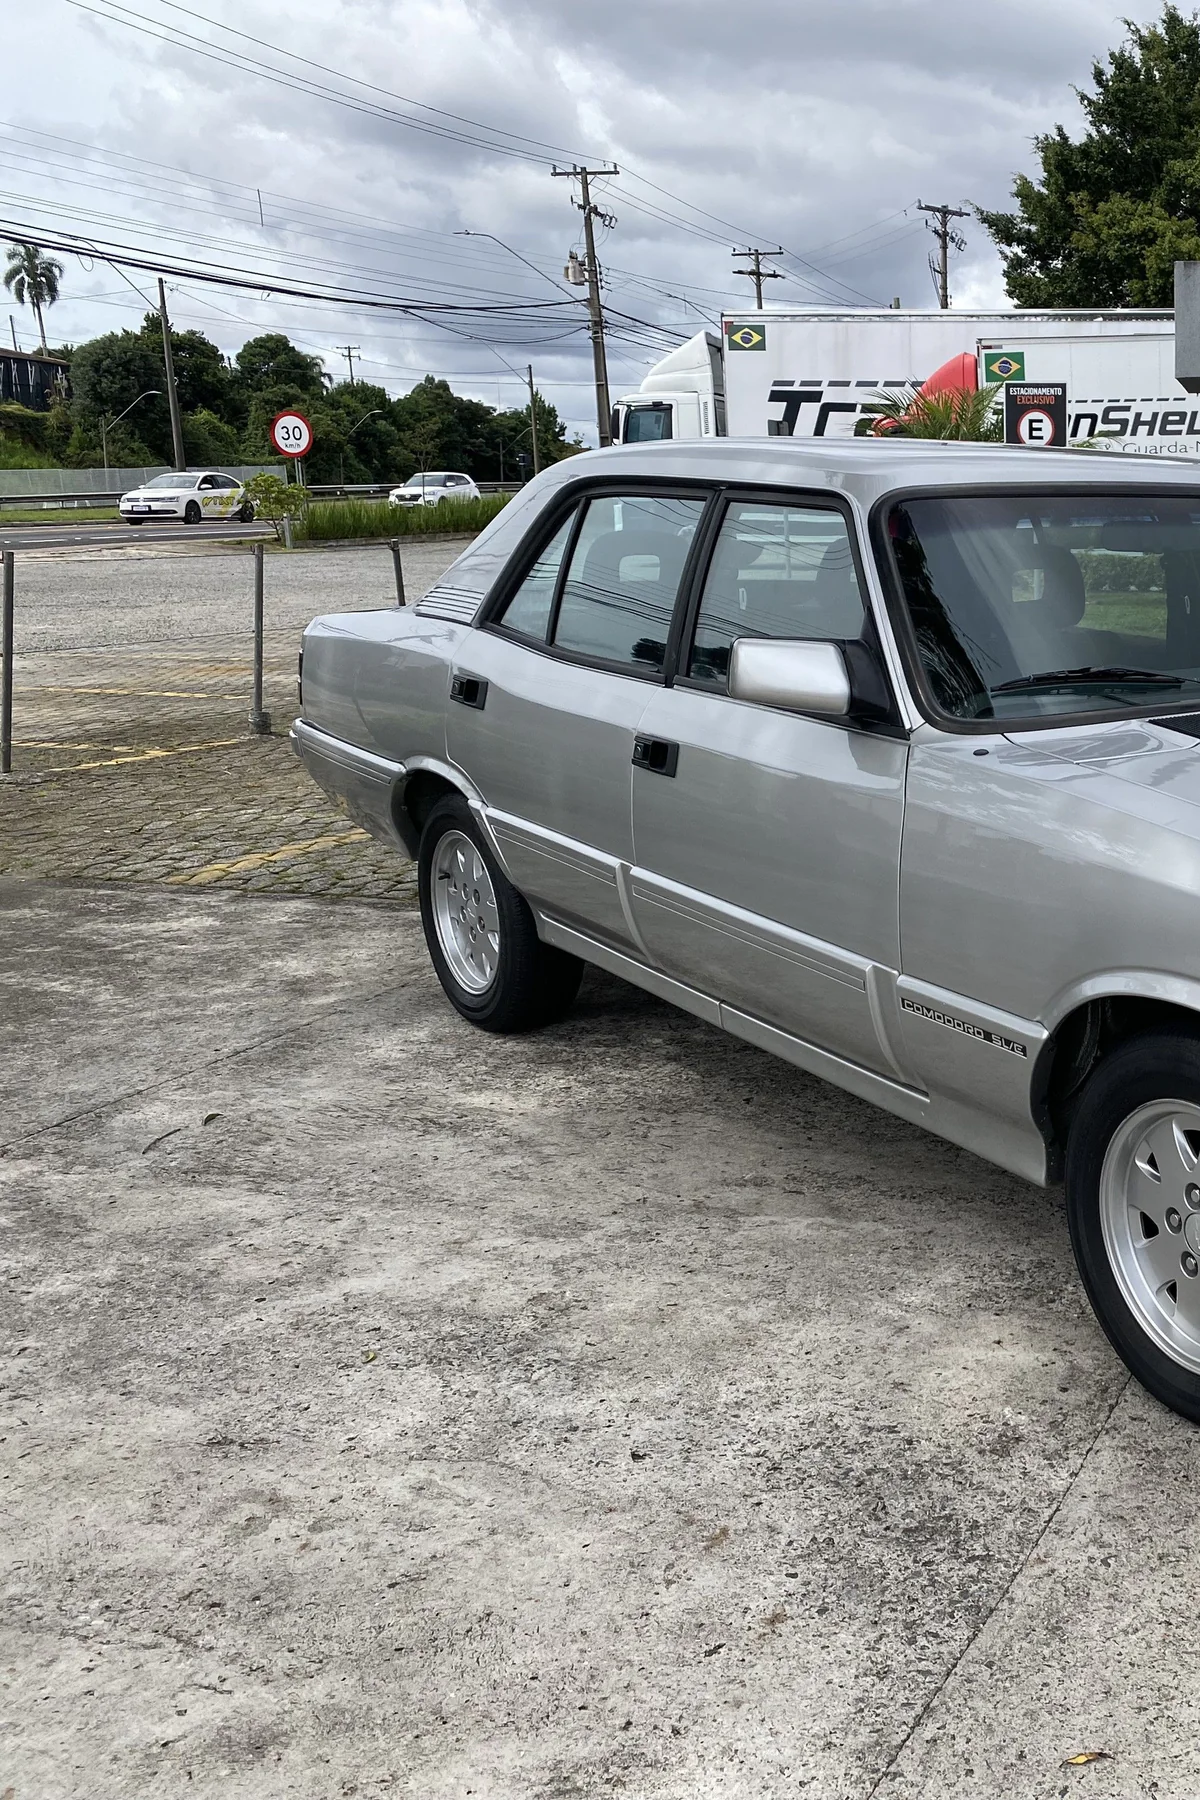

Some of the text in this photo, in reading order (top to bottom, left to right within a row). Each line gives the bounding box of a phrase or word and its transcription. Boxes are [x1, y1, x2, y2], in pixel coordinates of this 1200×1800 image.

[1009, 387, 1063, 396] ESTACIONAMENTO
[1016, 395, 1056, 405] EXCLUSIVO
[281, 425, 302, 441] 30
[1028, 419, 1044, 440] E
[904, 1000, 1024, 1055] COMODORO SL/E
